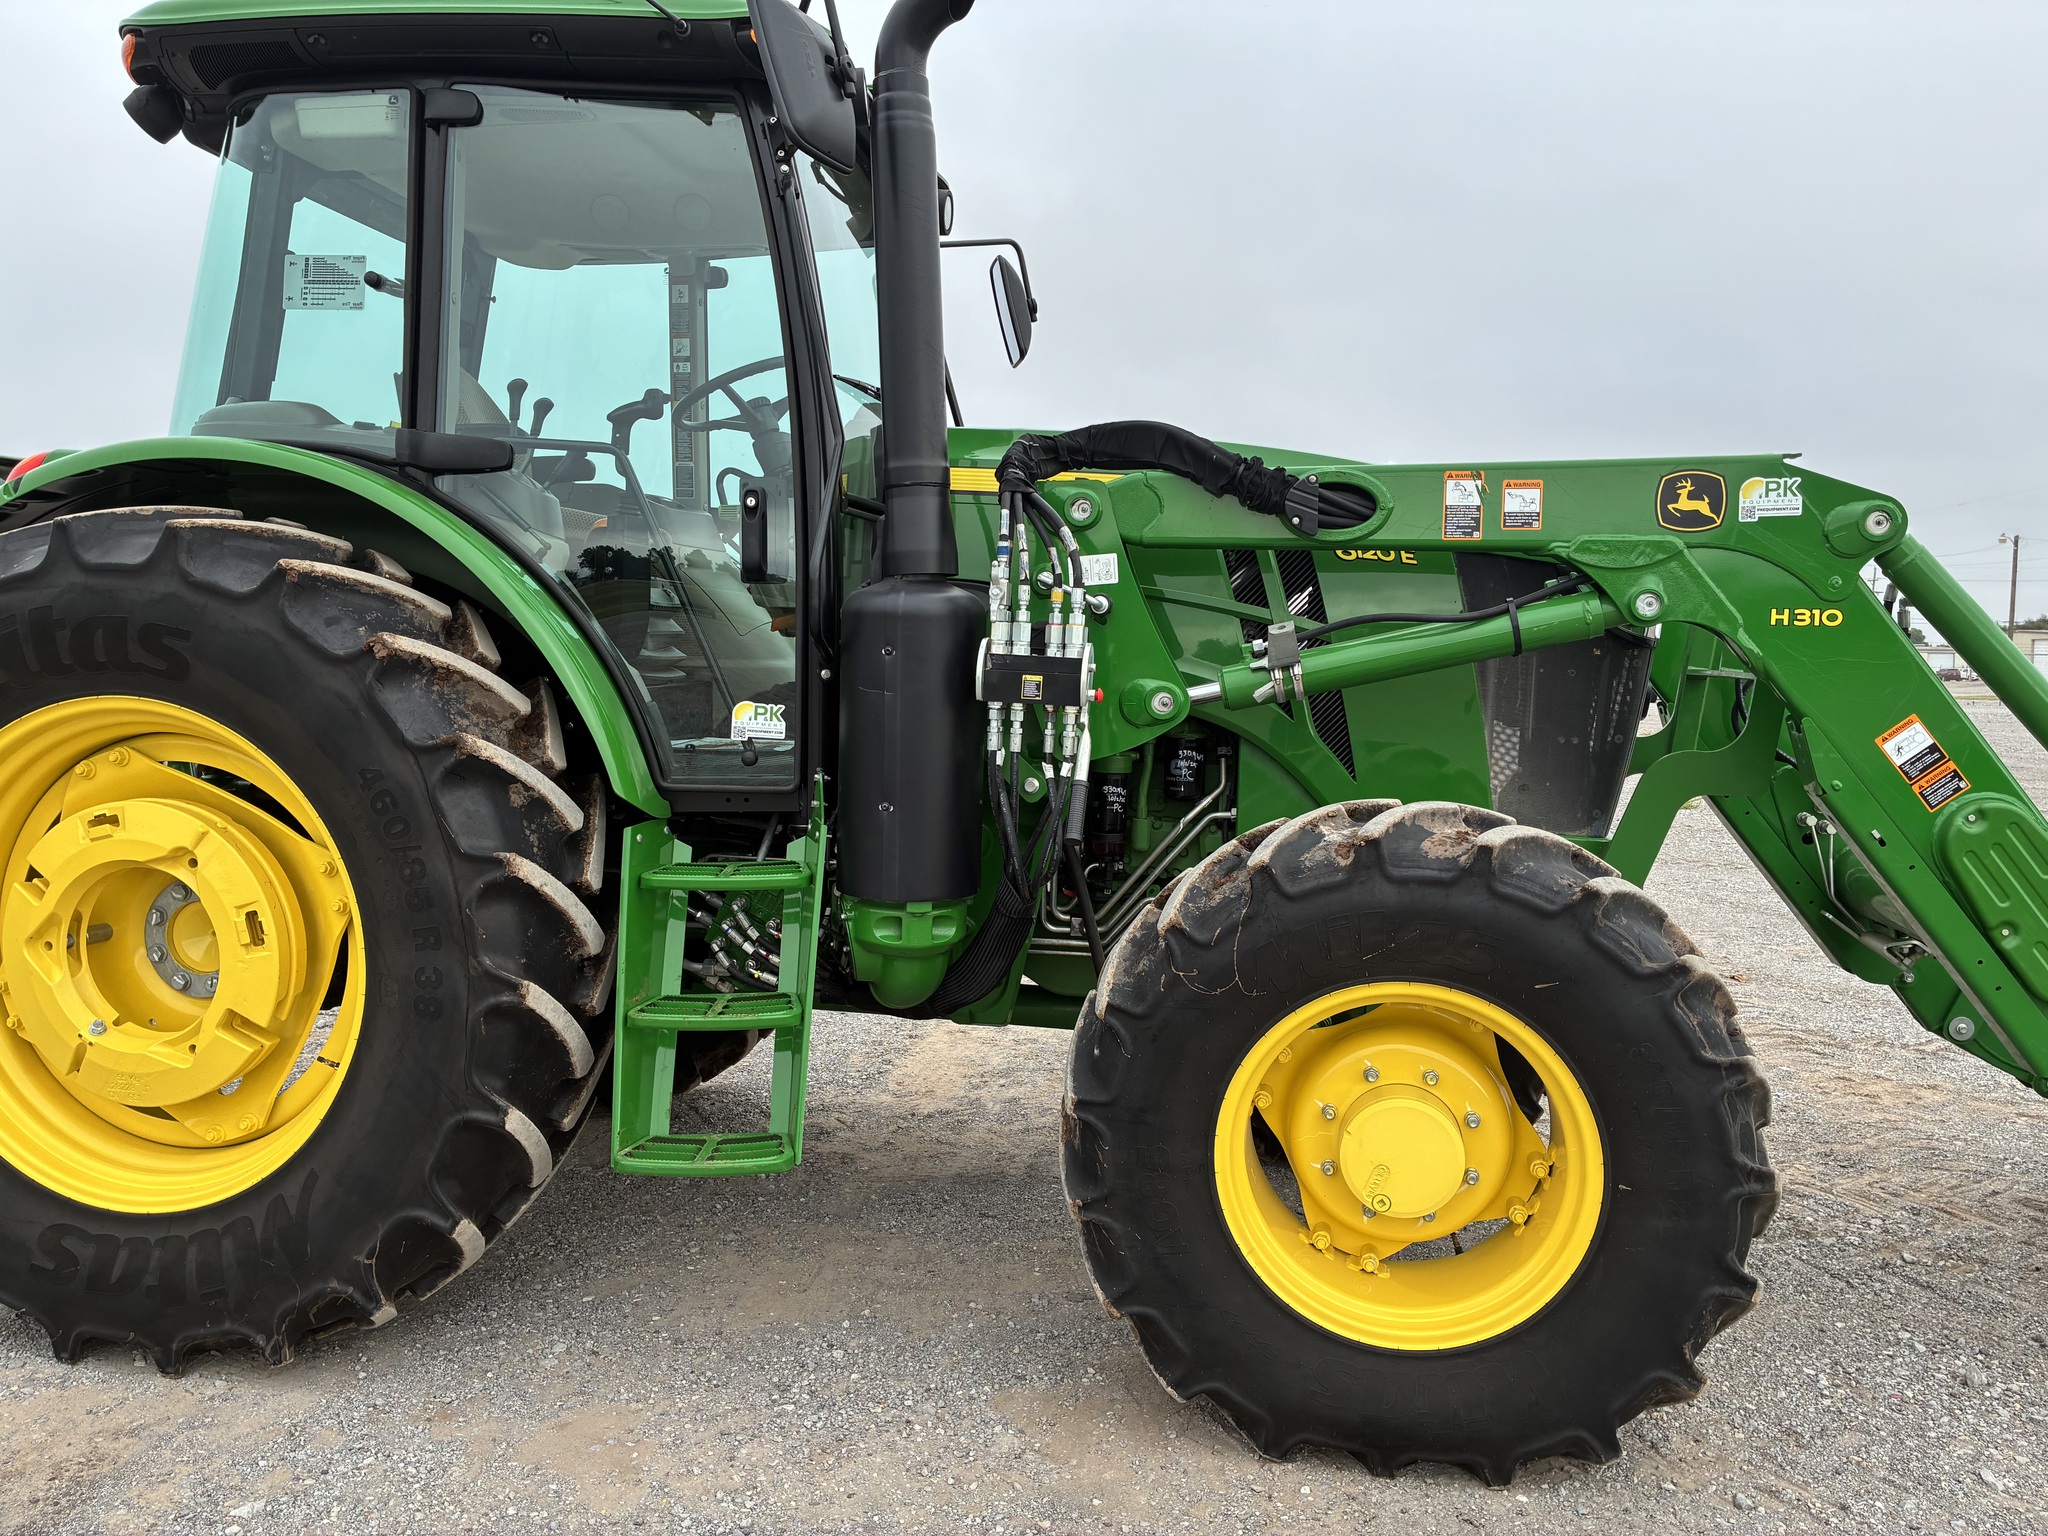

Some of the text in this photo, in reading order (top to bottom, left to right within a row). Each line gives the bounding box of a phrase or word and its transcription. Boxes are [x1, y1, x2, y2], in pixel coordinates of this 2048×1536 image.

[1764, 479, 1800, 498] P&K
[0, 604, 193, 692] itas
[753, 705, 784, 722] P&K
[1887, 718, 1914, 738] WARNING
[1925, 765, 1952, 785] WARNING
[1254, 909, 1504, 993] Mitas
[28, 1166, 320, 1310] Mitas
